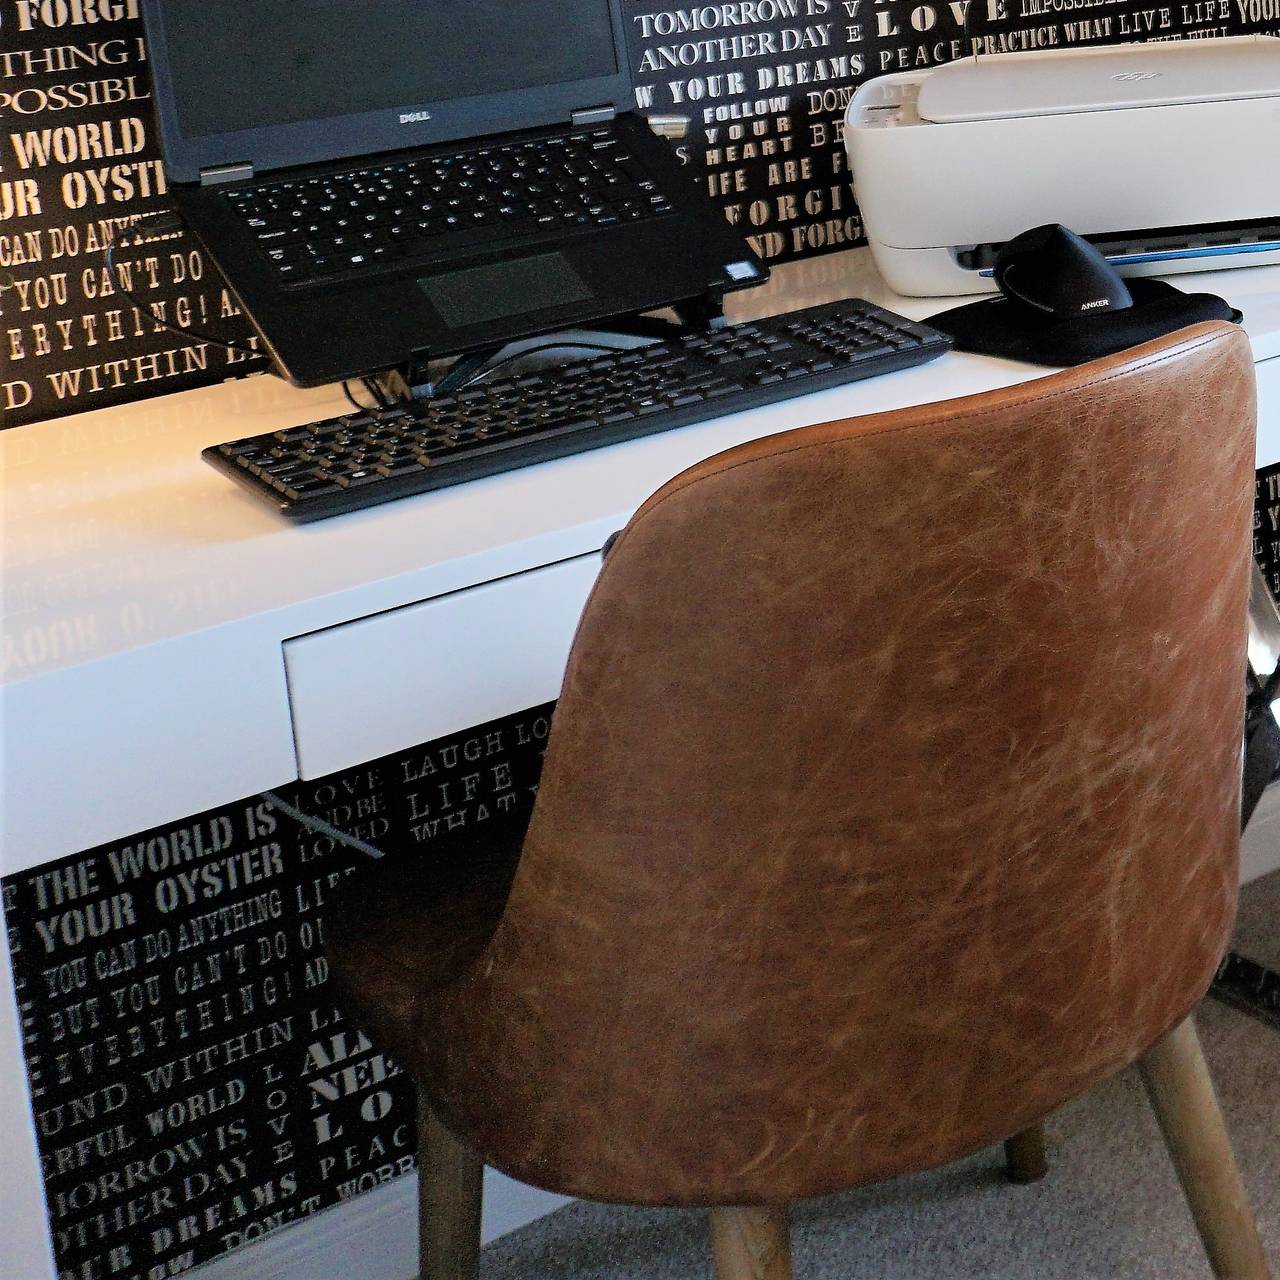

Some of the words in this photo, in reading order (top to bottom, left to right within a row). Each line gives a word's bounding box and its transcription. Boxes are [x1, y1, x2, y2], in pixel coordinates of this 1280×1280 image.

[399, 111, 431, 124] DELL
[11, 118, 145, 175] WORLD
[82, 257, 159, 298] CAN'T
[170, 251, 202, 283] DO
[1081, 299, 1109, 311] ANKER
[46, 344, 207, 399] WITHIN
[29, 858, 101, 913] THE
[108, 816, 235, 886] WORLD
[245, 800, 280, 840] IS
[34, 892, 137, 955] YOUR
[154, 842, 285, 914] OYSTER
